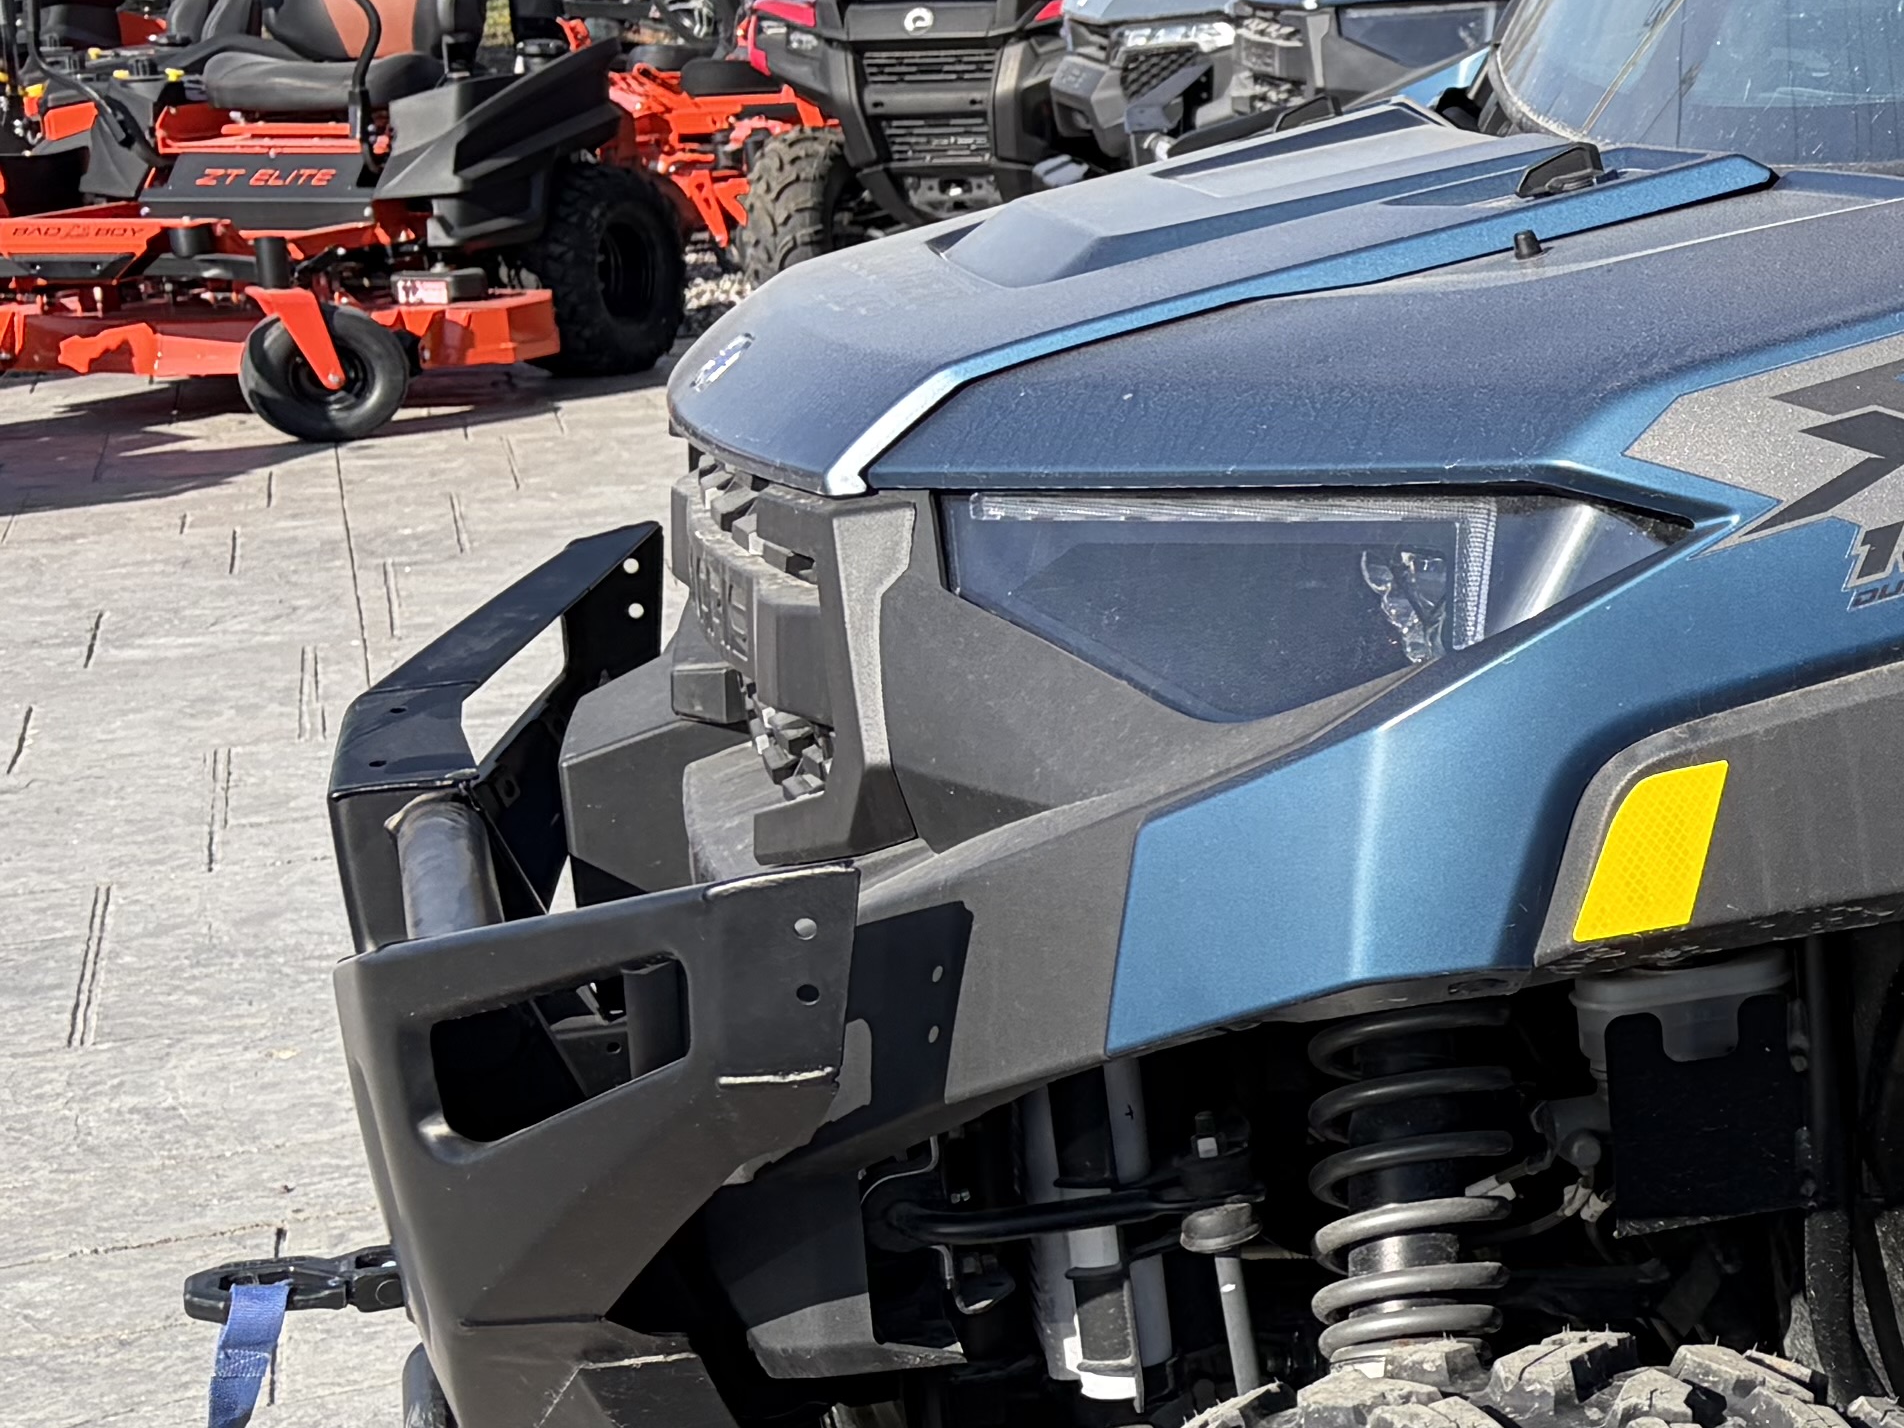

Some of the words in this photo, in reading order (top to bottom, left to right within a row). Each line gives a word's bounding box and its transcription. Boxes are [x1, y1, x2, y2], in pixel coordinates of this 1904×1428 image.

[195, 169, 246, 185] ZT
[249, 169, 336, 186] ELITE
[13, 227, 61, 237] BAD
[95, 227, 144, 237] BOY
